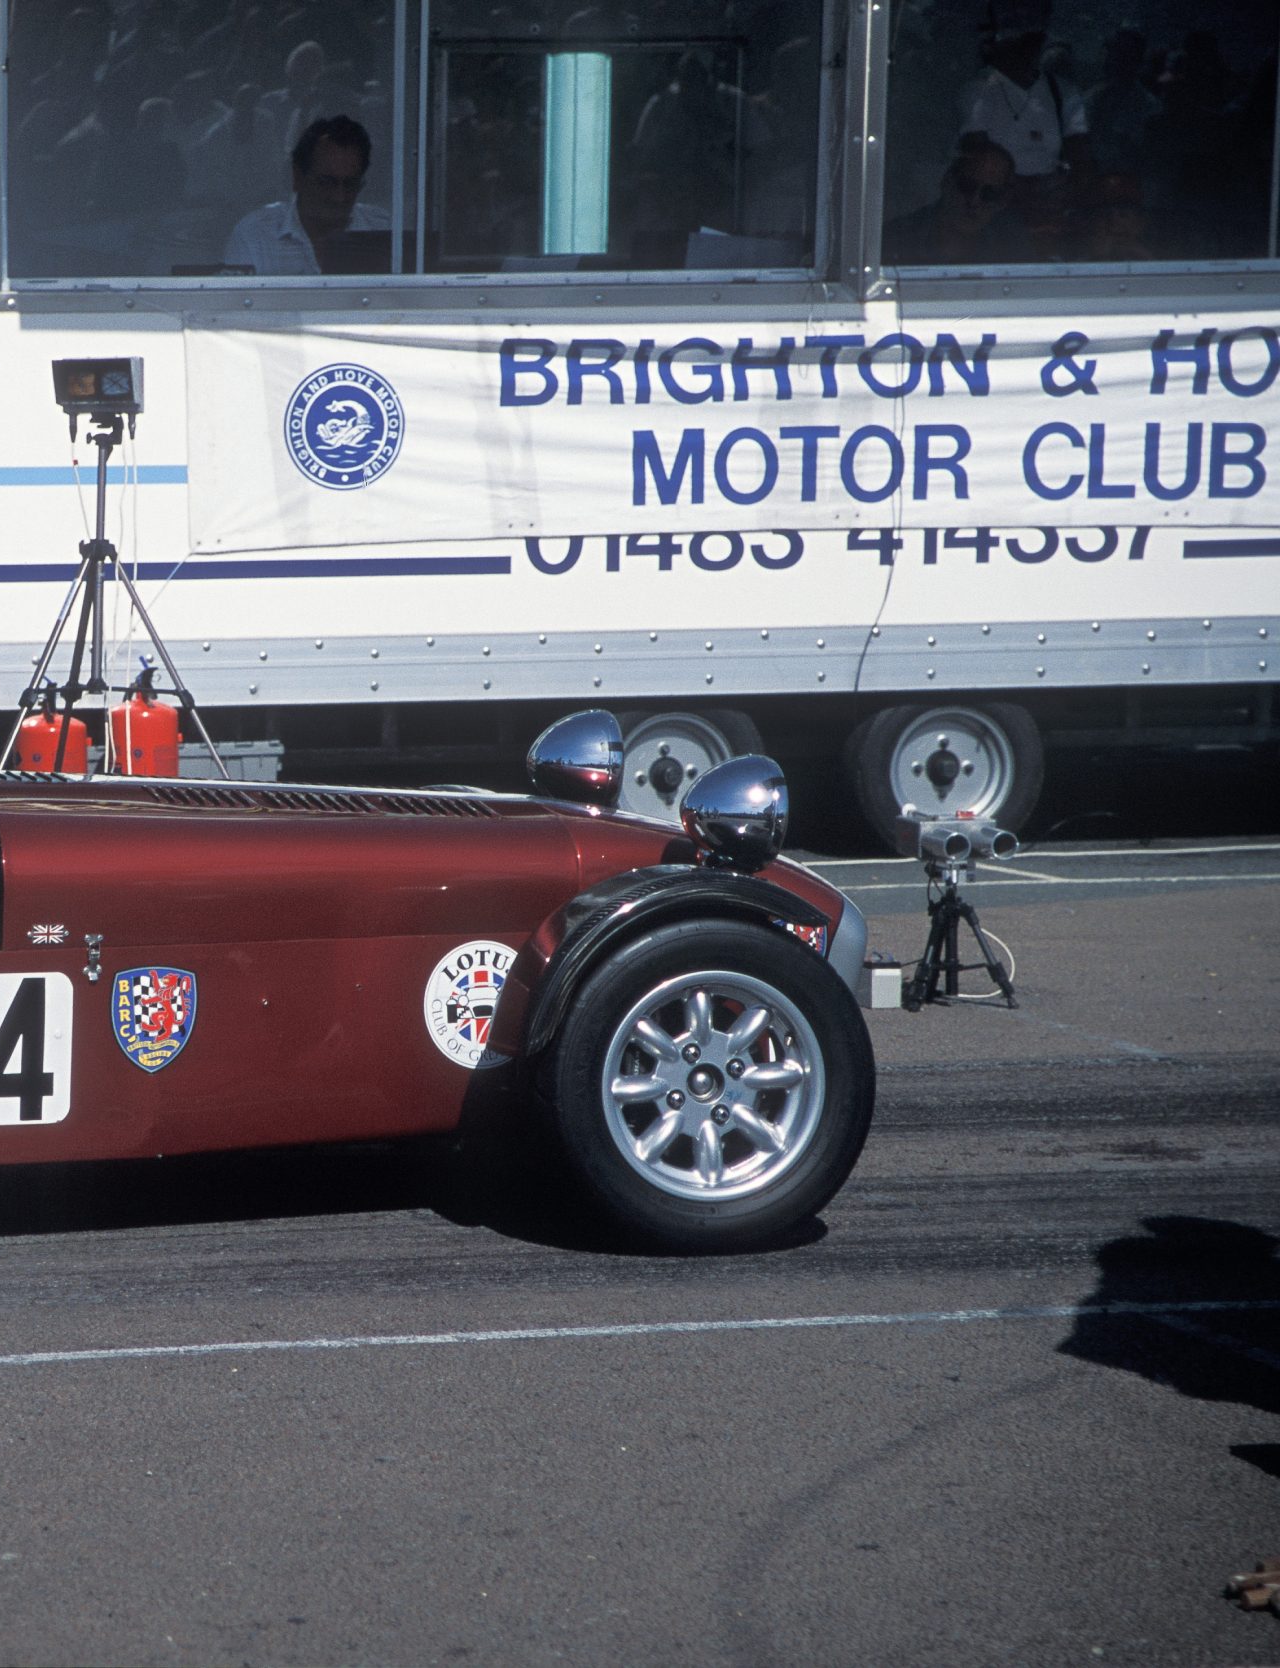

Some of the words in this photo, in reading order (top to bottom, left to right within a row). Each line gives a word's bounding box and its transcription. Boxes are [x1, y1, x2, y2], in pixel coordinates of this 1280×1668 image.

[301, 375, 329, 402] AND
[334, 370, 376, 388] HOVE
[499, 333, 996, 406] BRIGHTON
[1041, 332, 1097, 396] &
[375, 387, 399, 440] MOTOR
[291, 407, 328, 478] BRIGHTON
[364, 445, 394, 477] CLUB
[633, 425, 970, 505] MOTOR
[1024, 423, 1265, 499] CLUB
[441, 949, 510, 982] LOTU
[118, 979, 131, 1037] BARC
[431, 998, 448, 1036] CLUB
[447, 1037, 466, 1055] OF
